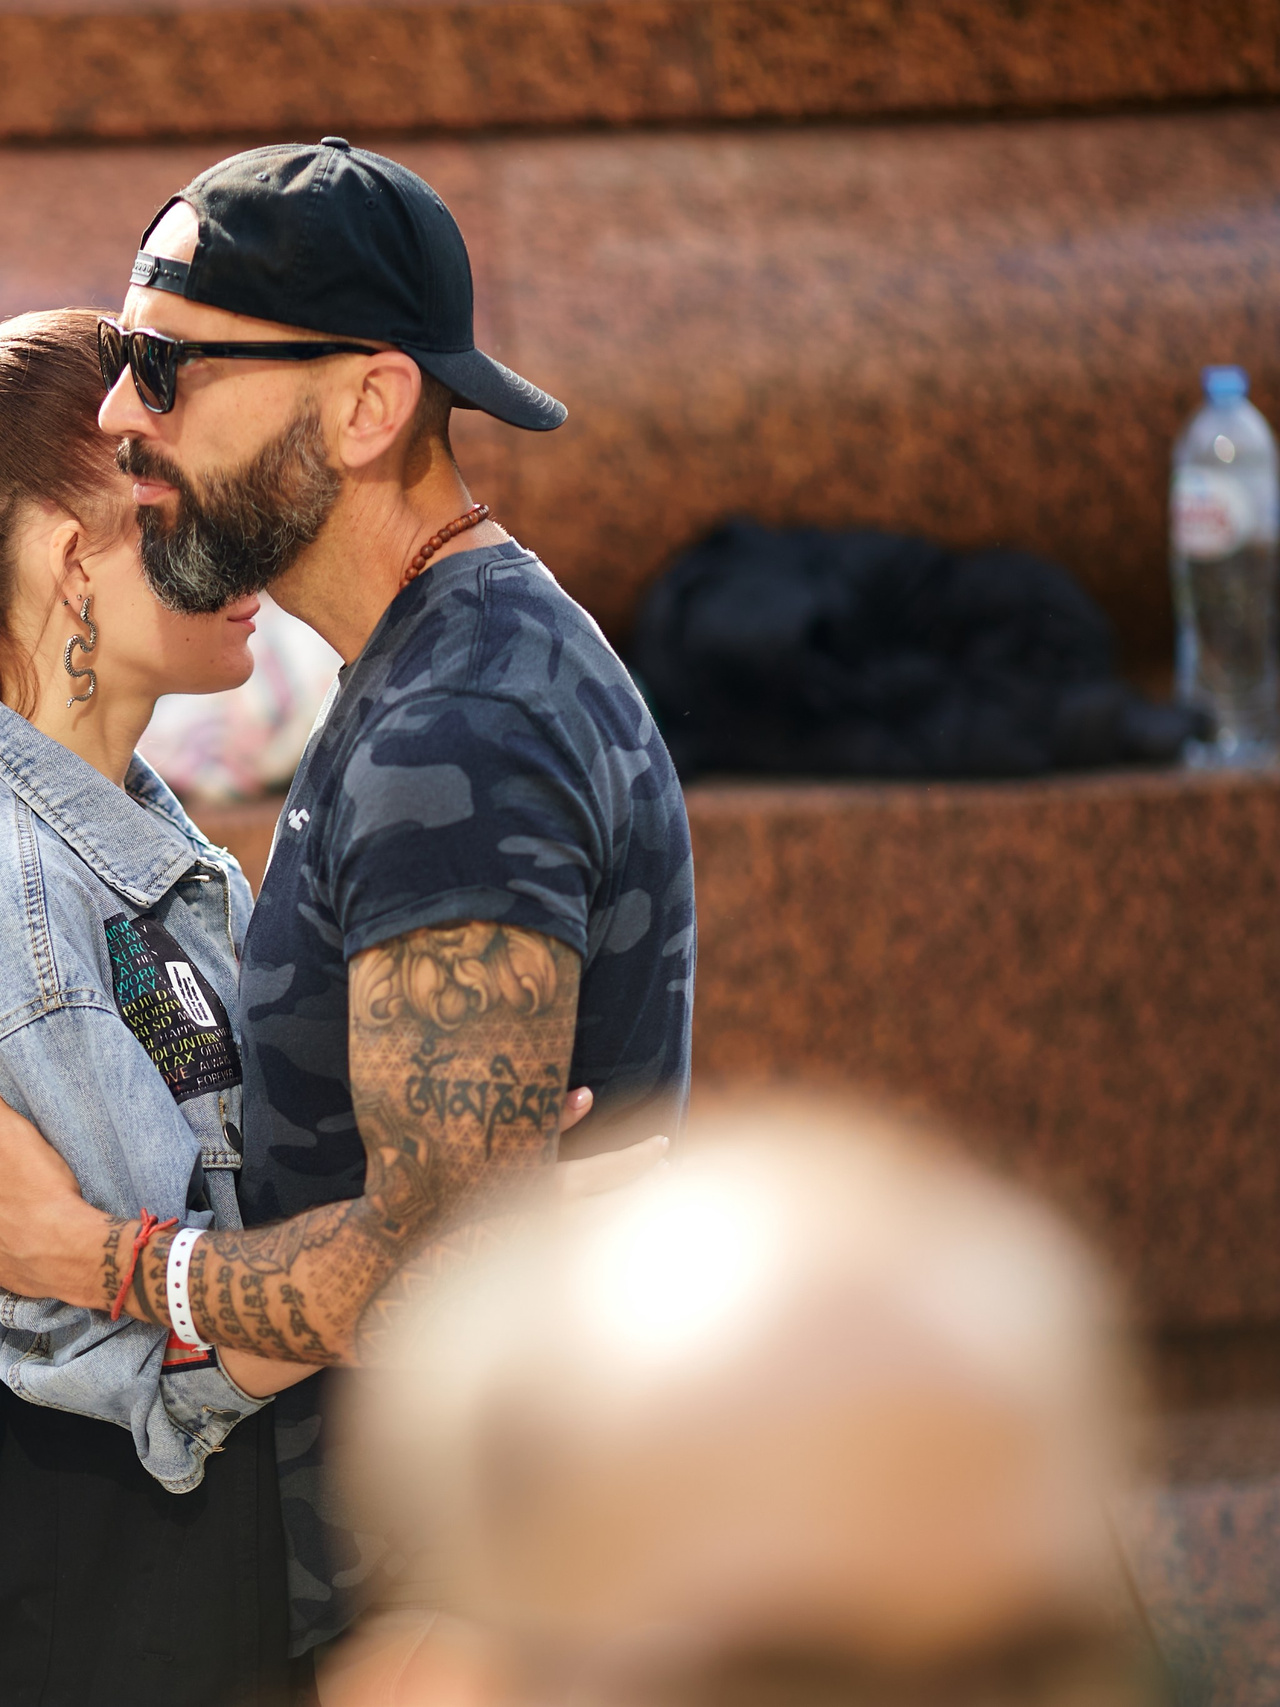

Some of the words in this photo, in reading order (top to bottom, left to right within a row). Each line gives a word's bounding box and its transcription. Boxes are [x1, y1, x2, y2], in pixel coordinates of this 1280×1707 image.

[113, 960, 134, 980] AT
[115, 966, 159, 994] WORK
[119, 978, 156, 1006] STAY
[129, 999, 181, 1028] WORRY
